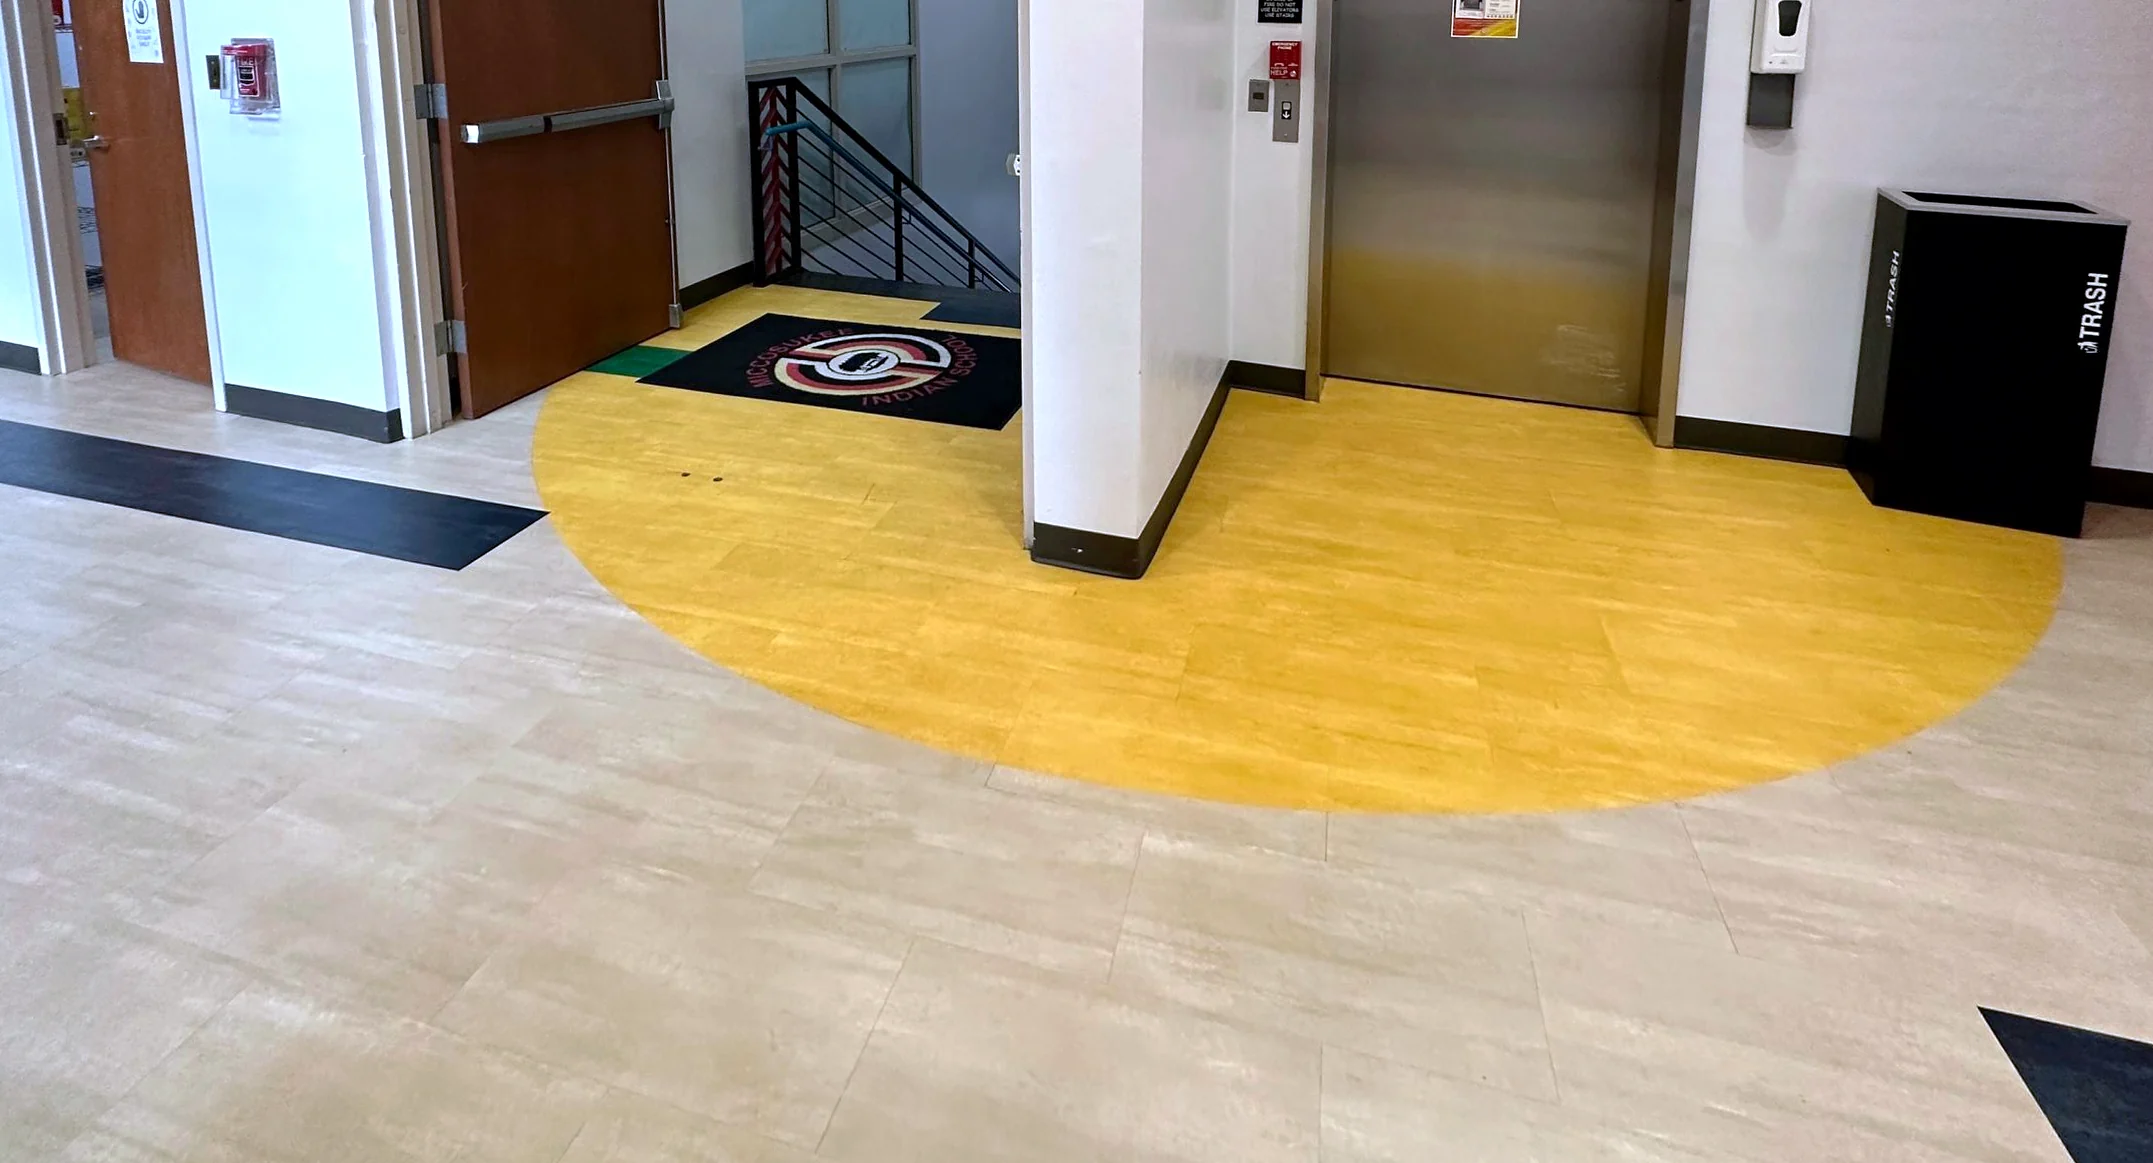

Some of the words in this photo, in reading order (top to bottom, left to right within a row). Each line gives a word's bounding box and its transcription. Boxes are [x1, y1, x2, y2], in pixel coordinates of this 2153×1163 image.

[1886, 250, 1900, 312] TRASH
[2079, 273, 2109, 338] TRASH
[746, 328, 854, 388] MICCOSUKEE
[861, 377, 959, 406] INDIAN
[941, 334, 979, 377] SCHOOL
